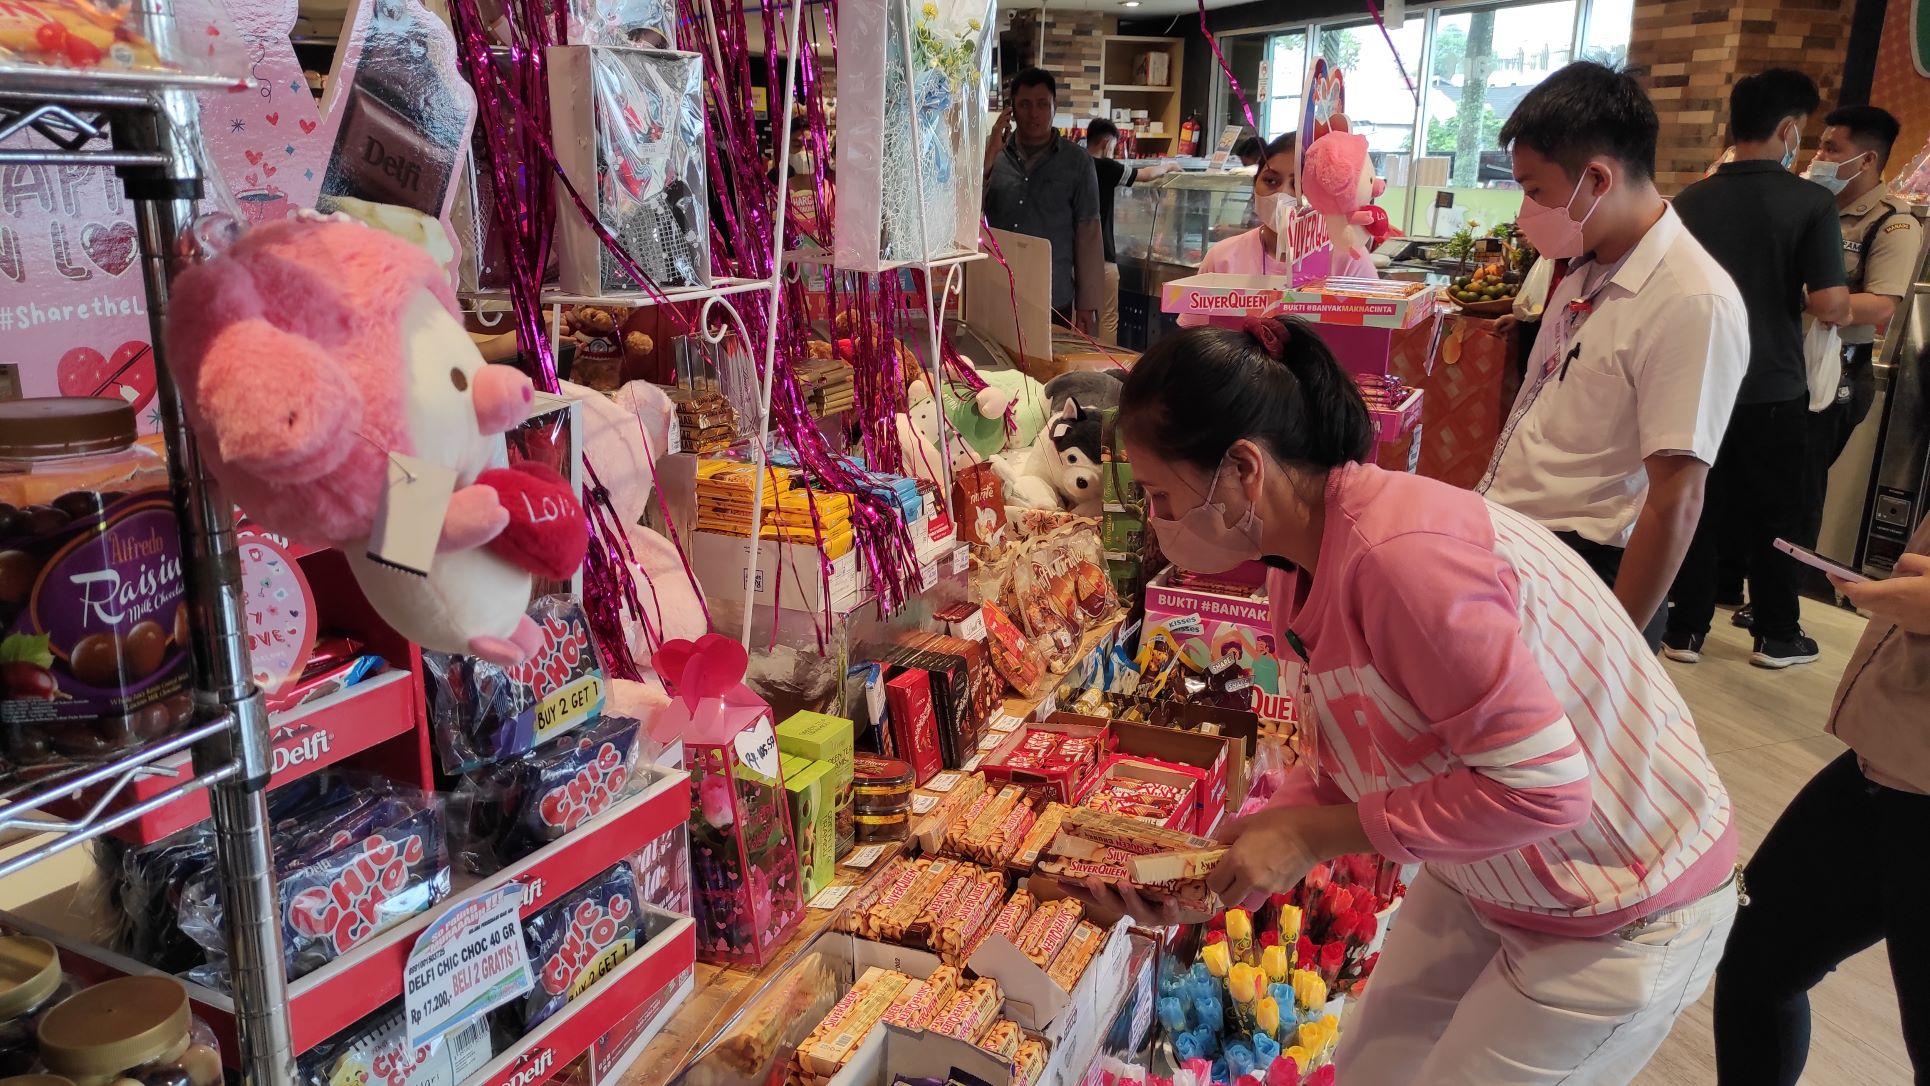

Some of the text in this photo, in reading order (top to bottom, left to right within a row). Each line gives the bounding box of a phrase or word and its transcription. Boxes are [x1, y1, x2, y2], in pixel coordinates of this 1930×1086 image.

[364, 134, 422, 192] Delfi
[108, 526, 164, 565] Alfredo
[69, 553, 182, 628] Raisin
[1158, 594, 1198, 610] BUKTI
[537, 681, 599, 730] BUY 2 GET 1
[271, 727, 331, 774] Delfi
[540, 742, 621, 827] CHIC
[289, 834, 398, 937] CHIC
[881, 868, 919, 908] SILVERQUEEN
[1070, 861, 1127, 877] SILVERQUEEN
[518, 878, 543, 908] lfi
[955, 882, 988, 921] SILVERQUEEN
[540, 898, 603, 996] CHIC
[571, 894, 631, 981] HOC
[1040, 908, 1075, 953] SILVERQUEEN
[408, 922, 516, 995] DELFI CHIC CHOC 40 GR
[599, 951, 617, 976] GET
[411, 1008, 422, 1025] Rp
[452, 967, 473, 997] BELI
[473, 962, 481, 984] 2
[481, 945, 514, 981] GRATIS
[514, 939, 521, 962] 1
[823, 991, 857, 1027] SILVERQUEEN
[500, 1048, 553, 1086] Delfi
